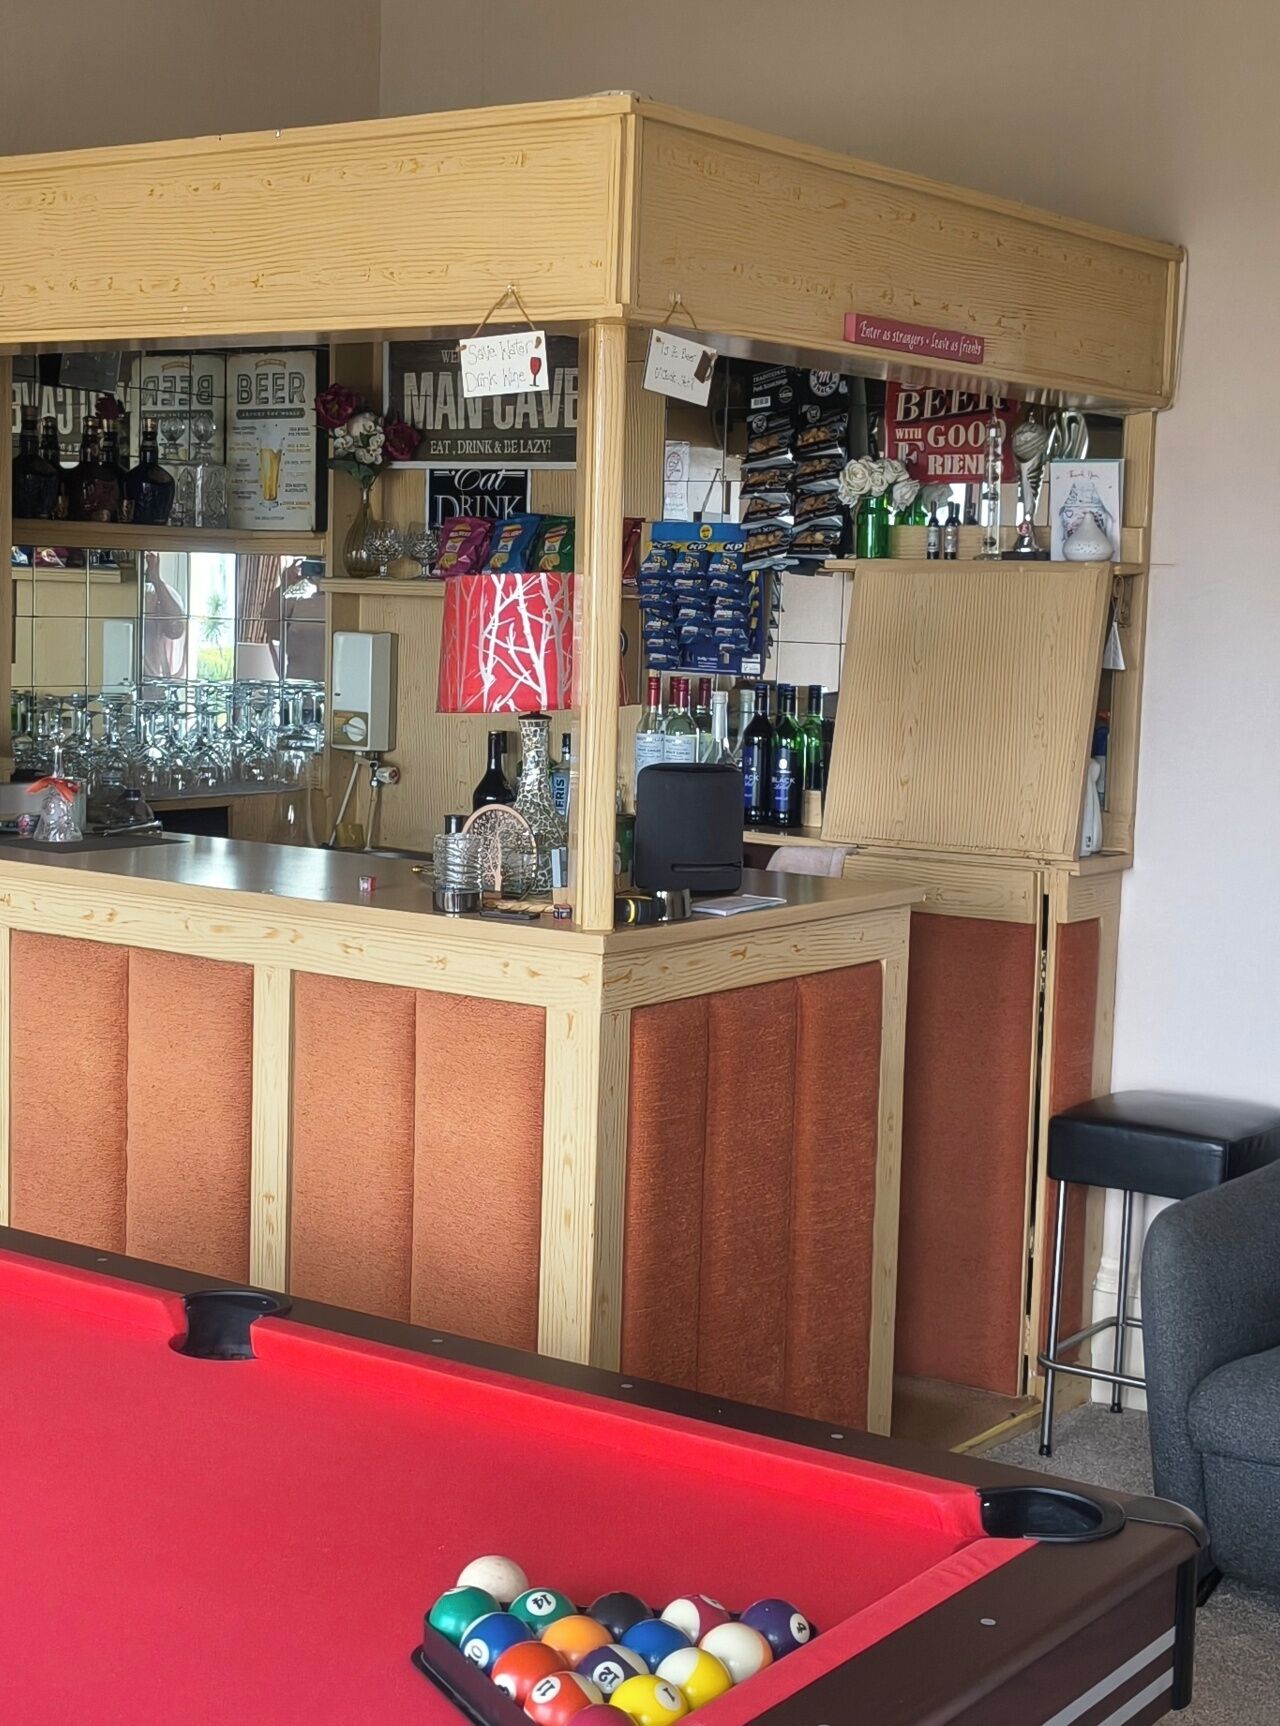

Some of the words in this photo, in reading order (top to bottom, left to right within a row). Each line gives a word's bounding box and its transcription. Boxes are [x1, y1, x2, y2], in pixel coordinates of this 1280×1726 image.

[860, 320, 881, 338] Enter
[882, 331, 891, 341] as
[892, 331, 924, 350] strangers
[931, 332, 950, 350] Leave
[950, 340, 959, 351] as
[959, 336, 982, 357] friends
[467, 344, 497, 365] Save
[237, 372, 306, 405] BEER
[465, 370, 497, 392] Drink
[458, 440, 492, 454] DRINK
[494, 440, 501, 453] &
[504, 440, 518, 454] BE
[520, 440, 551, 453] LAZY!
[434, 495, 523, 528] DRINK
[532, 1594, 552, 1610] 14
[797, 1622, 807, 1634] 4
[599, 1666, 620, 1685] 12
[536, 1680, 556, 1697] 11
[663, 1687, 675, 1702] 1
